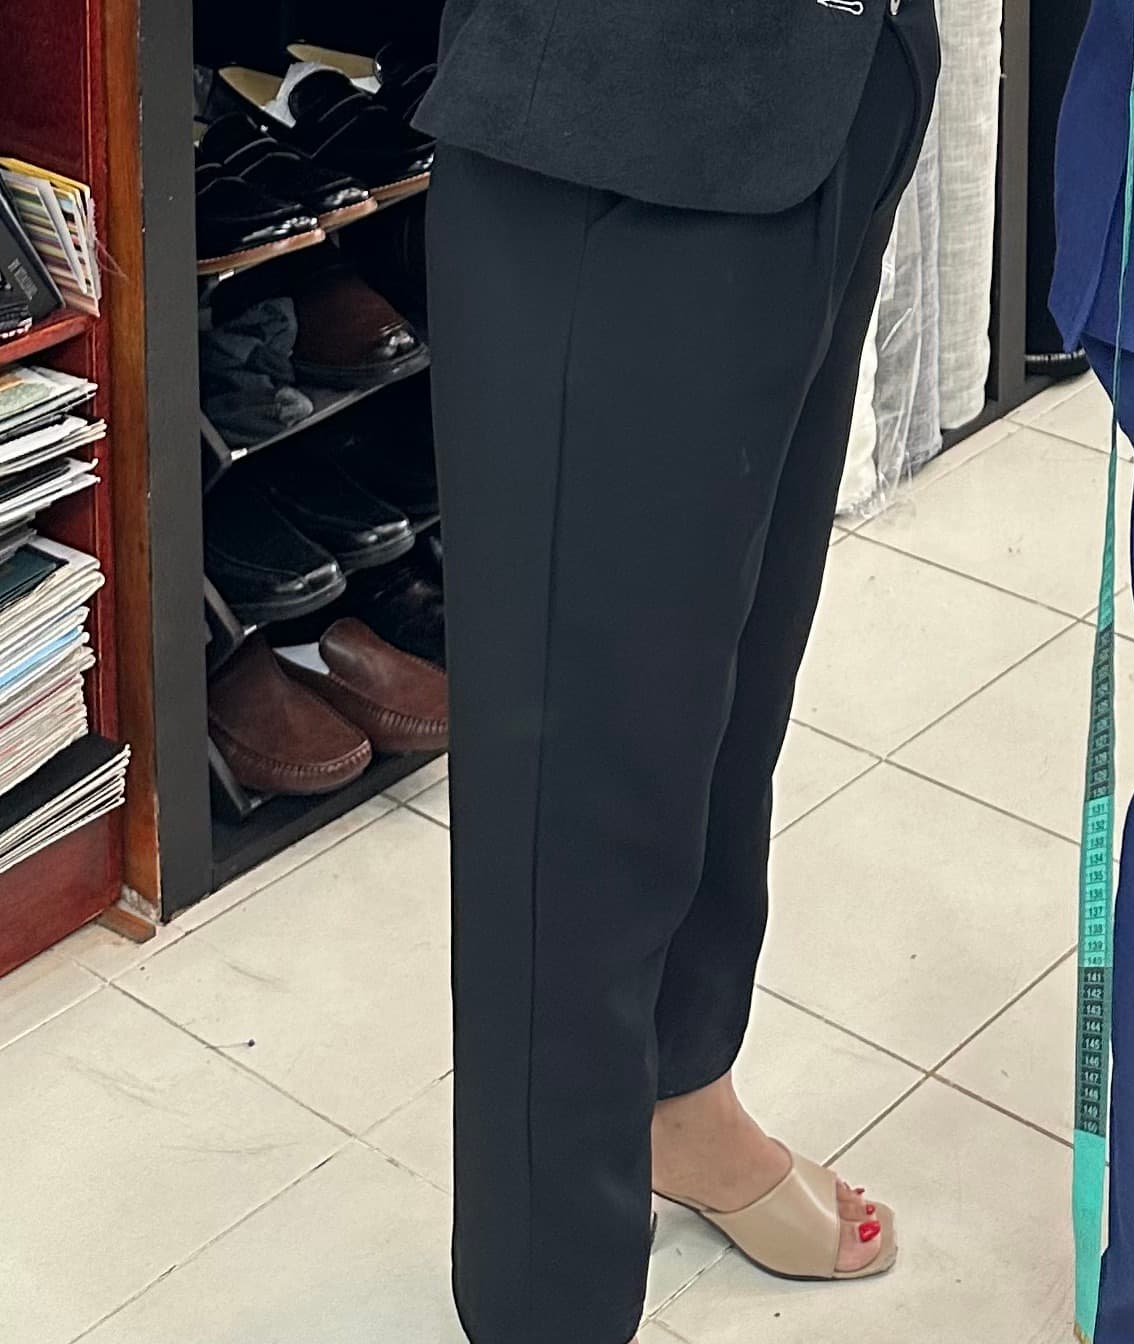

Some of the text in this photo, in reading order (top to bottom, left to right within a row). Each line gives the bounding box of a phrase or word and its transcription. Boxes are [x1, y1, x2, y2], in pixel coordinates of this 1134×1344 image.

[1086, 972, 1101, 983] 141
[1086, 988, 1102, 1000] 142
[1085, 1021, 1101, 1032] 144
[1085, 1038, 1100, 1050] 145
[1085, 1055, 1100, 1067] 146
[1084, 1071, 1099, 1083] 147
